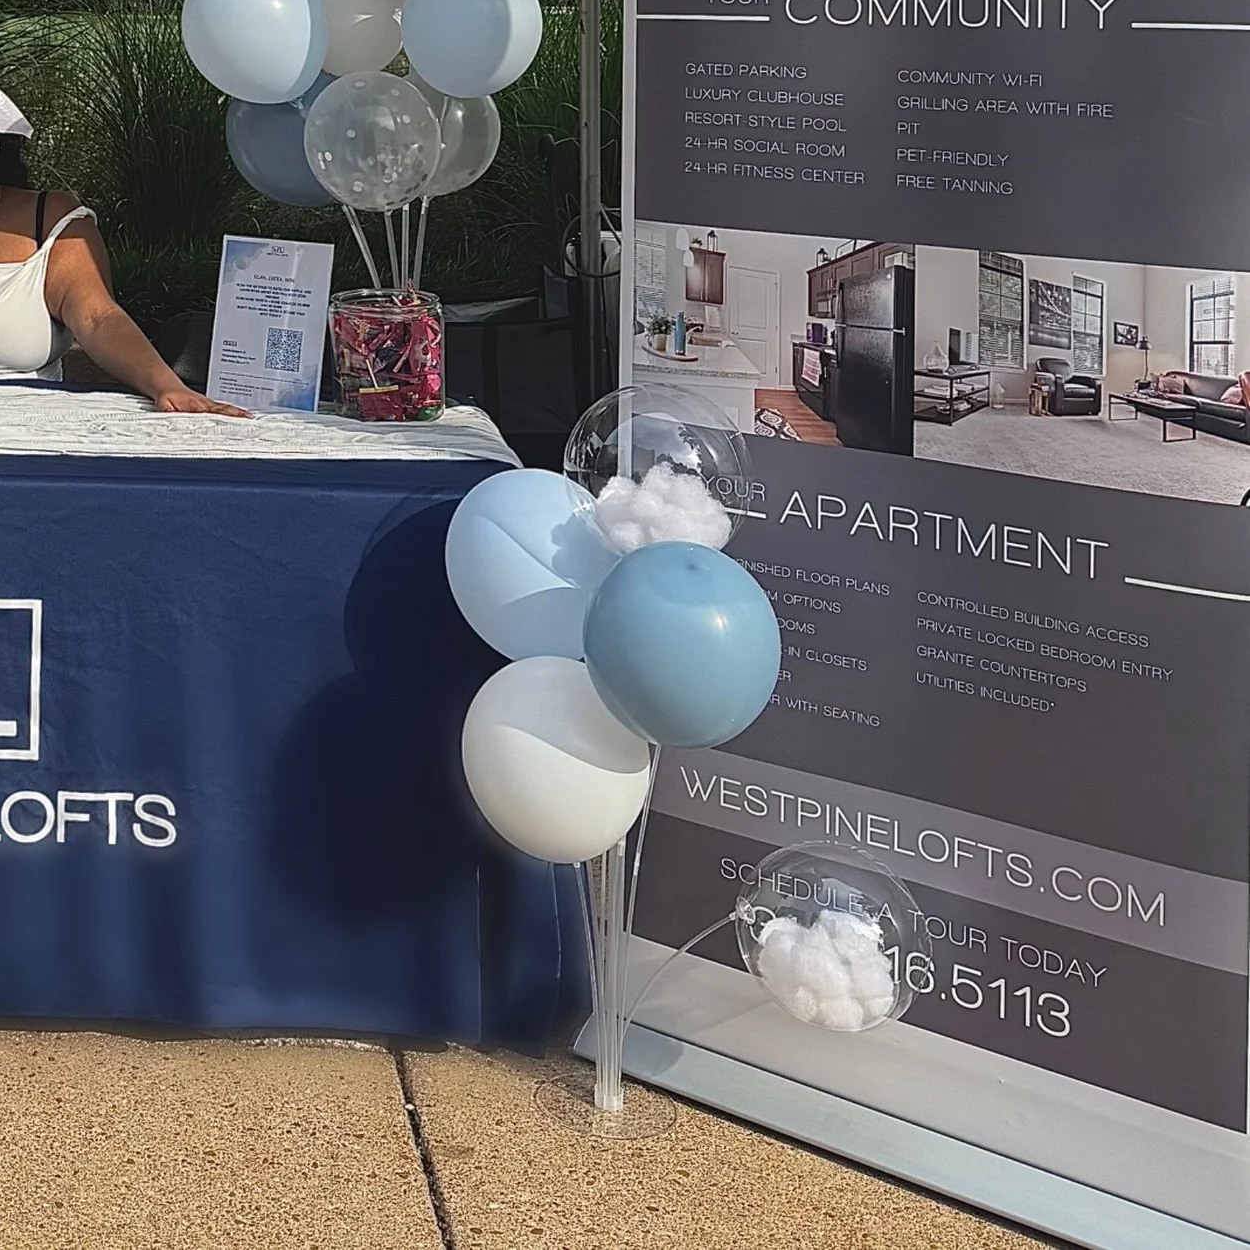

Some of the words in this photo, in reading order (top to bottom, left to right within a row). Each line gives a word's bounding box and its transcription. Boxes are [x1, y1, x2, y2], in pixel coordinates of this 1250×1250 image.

[685, 62, 733, 76] GATED
[739, 65, 807, 79] PARKING
[897, 70, 995, 85] COMMUNITY
[1002, 73, 1042, 87] WI-FI
[685, 87, 741, 101] LUXURY
[747, 90, 844, 106] CLUBHOUSE
[897, 96, 968, 111] GRILLING
[975, 100, 1019, 114] AREA
[1026, 102, 1070, 116] WITH
[1077, 103, 1113, 118] FIRE
[685, 111, 796, 129] RESORT-STYLE
[802, 117, 847, 132] POOL
[897, 122, 920, 135] PIT
[684, 136, 728, 150] 24-HR
[733, 139, 789, 154] SOCIAL
[796, 143, 845, 157] ROOM
[897, 149, 1008, 167] PET-FRIENDLY
[684, 161, 728, 175] 24-HR
[733, 164, 794, 180] FITNESS
[801, 169, 865, 184] CENTER
[896, 175, 935, 189] FREE
[942, 178, 1013, 195] TANNING
[700, 472, 766, 502] YOUR
[779, 491, 1109, 579] APARTMENT
[796, 569, 840, 587] FLOOR
[845, 579, 890, 596] PLANS
[783, 593, 842, 614] OPTIONS
[917, 591, 1009, 620] CONTROLLED
[1014, 611, 1080, 634] BUILDING
[1086, 625, 1149, 647] ACCESS
[806, 649, 867, 671] CLOSETS
[917, 618, 972, 640] PRIVATE
[977, 631, 1035, 653] LOCKED
[1040, 644, 1116, 670] BEDROOM
[1122, 661, 1173, 681] ENTRY
[917, 645, 974, 668] GRANITE
[980, 659, 1087, 692] COUNTERTOPS
[916, 672, 975, 695] UTILITIES
[786, 697, 818, 714] WITH
[823, 705, 882, 727] SEATING
[680, 766, 1166, 927] WESTPINELOFTS.COM
[720, 858, 865, 917] SCHEDULE
[877, 902, 898, 928] A
[908, 908, 987, 953] TOUR
[1000, 936, 1107, 988] TODAY
[883, 945, 1071, 1038] 16.5113
